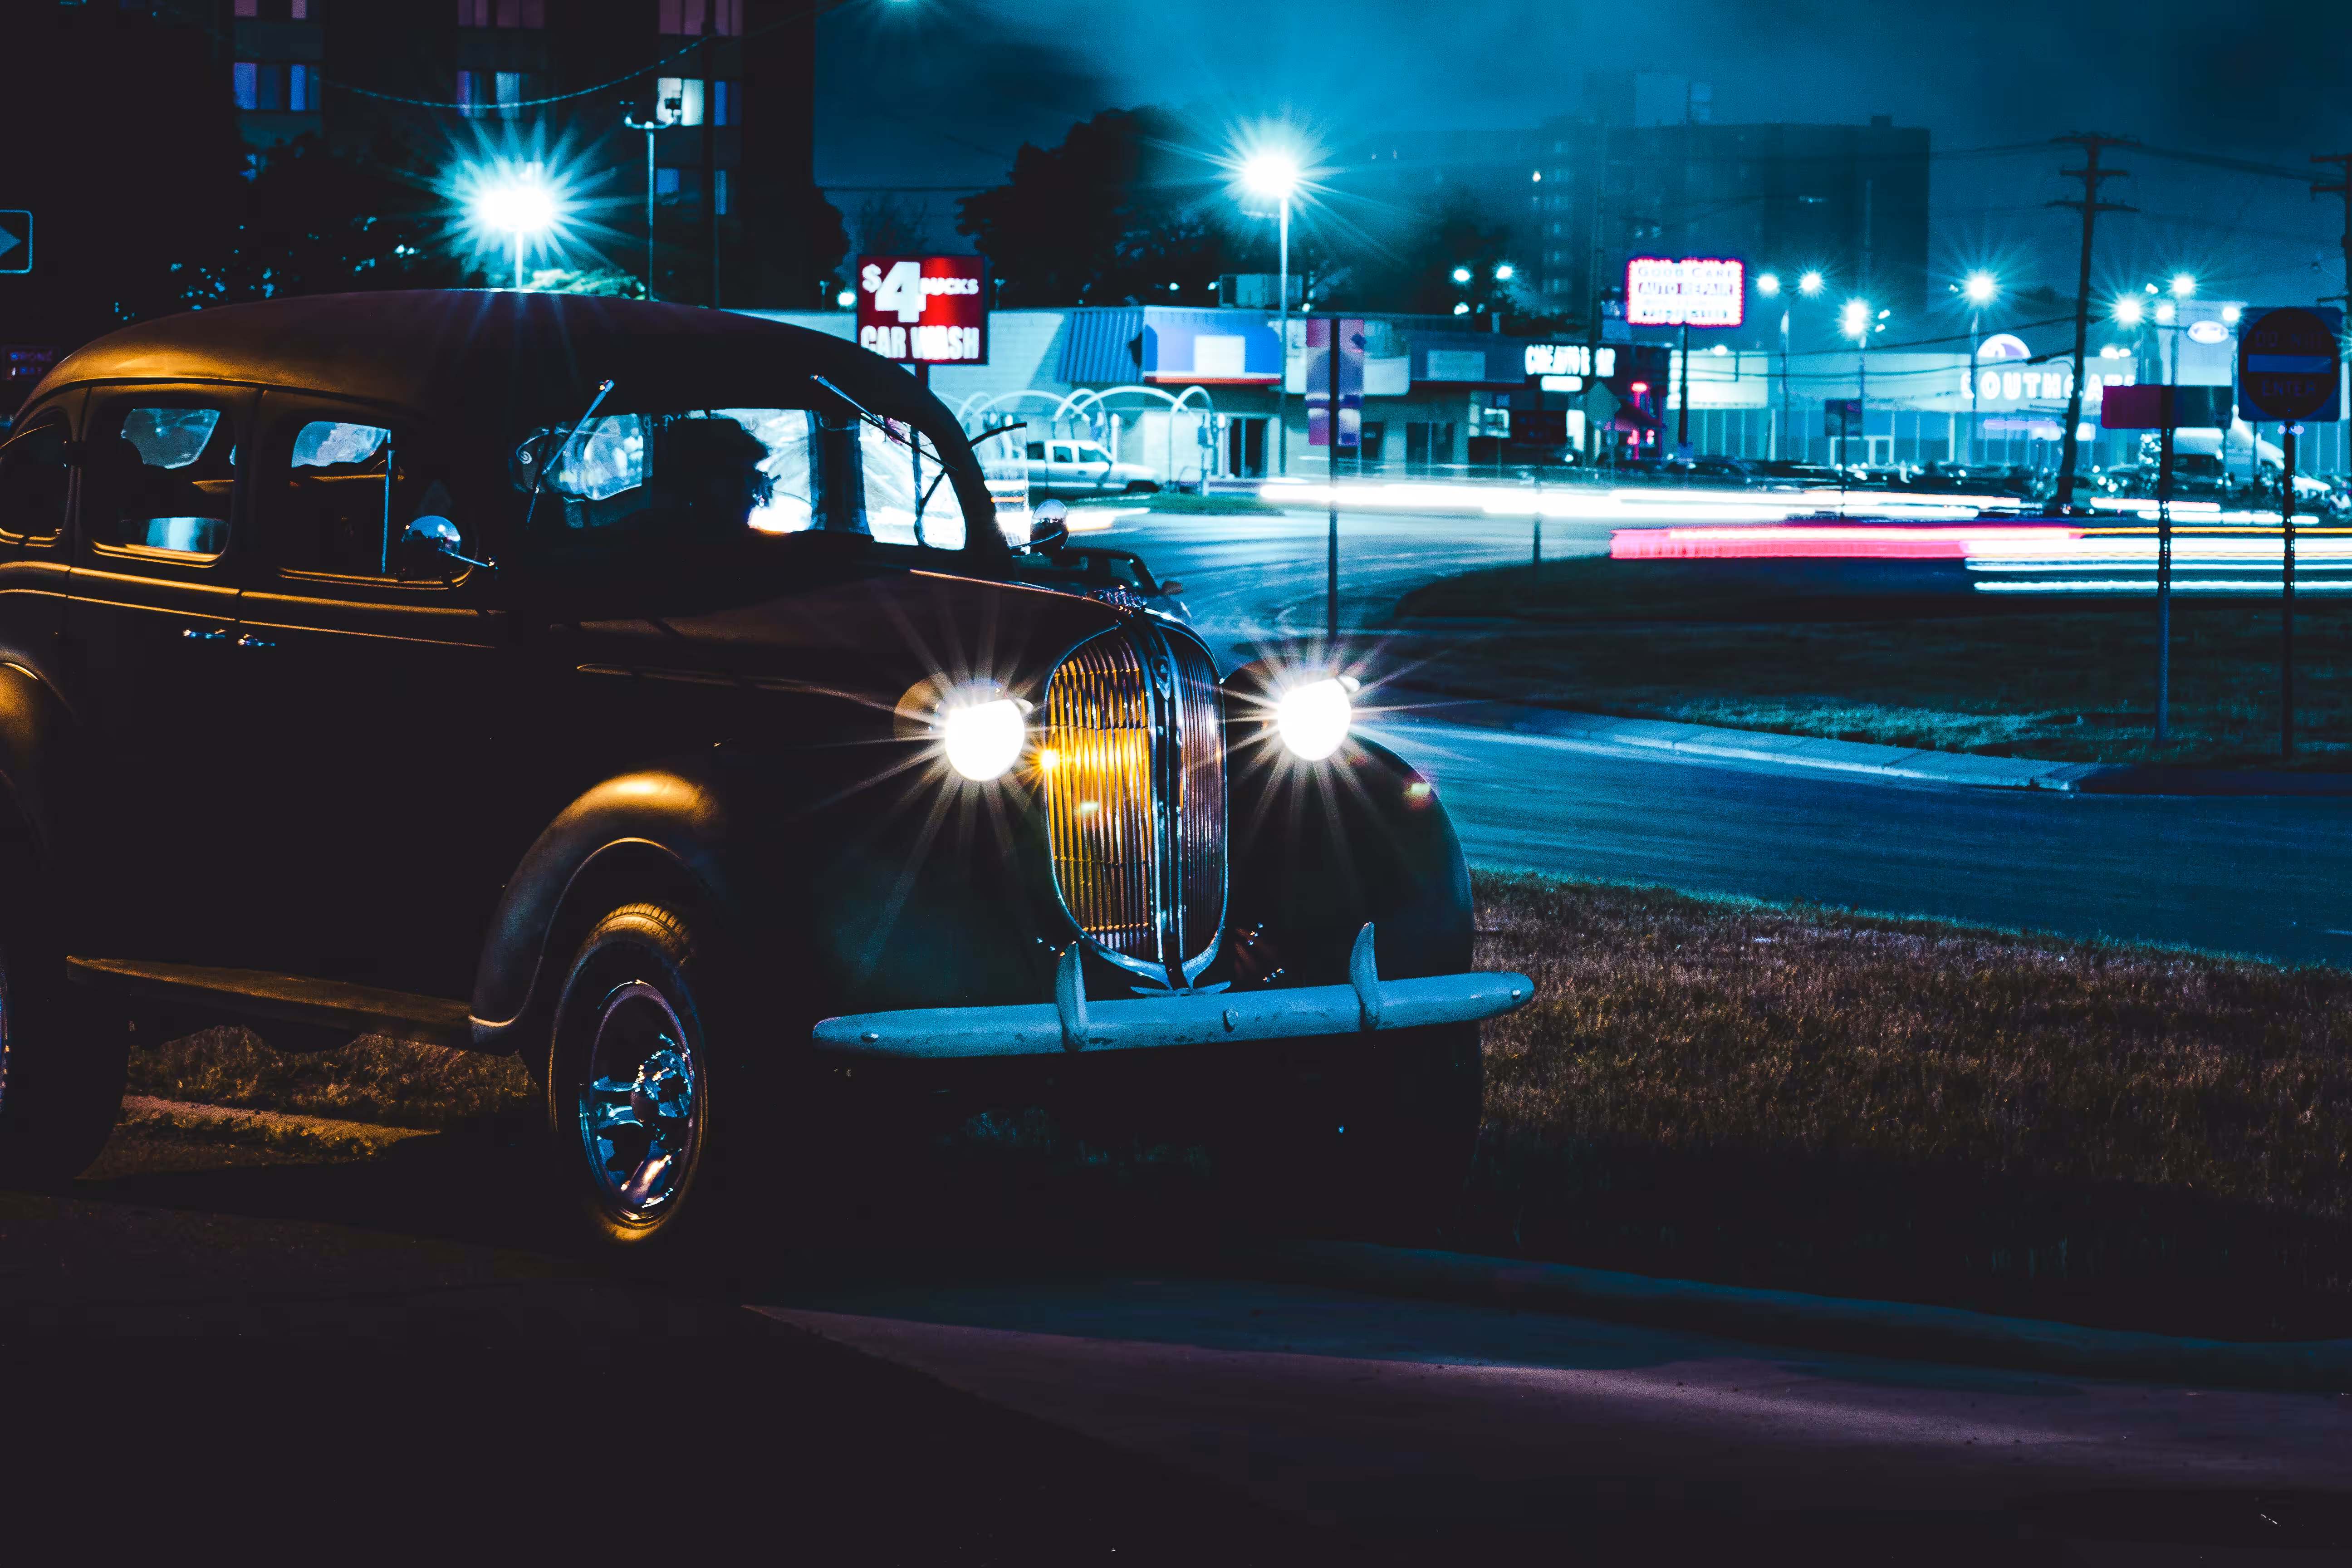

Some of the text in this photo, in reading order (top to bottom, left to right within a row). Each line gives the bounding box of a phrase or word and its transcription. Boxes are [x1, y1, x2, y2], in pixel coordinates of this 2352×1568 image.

[1638, 267, 1684, 277] GOOD
[920, 277, 979, 295] BUCKS
[1639, 282, 1678, 295] AUTO
[861, 325, 979, 359] CAR WASH
[2255, 331, 2323, 349] DO NOT
[2262, 380, 2316, 397] ENTER
